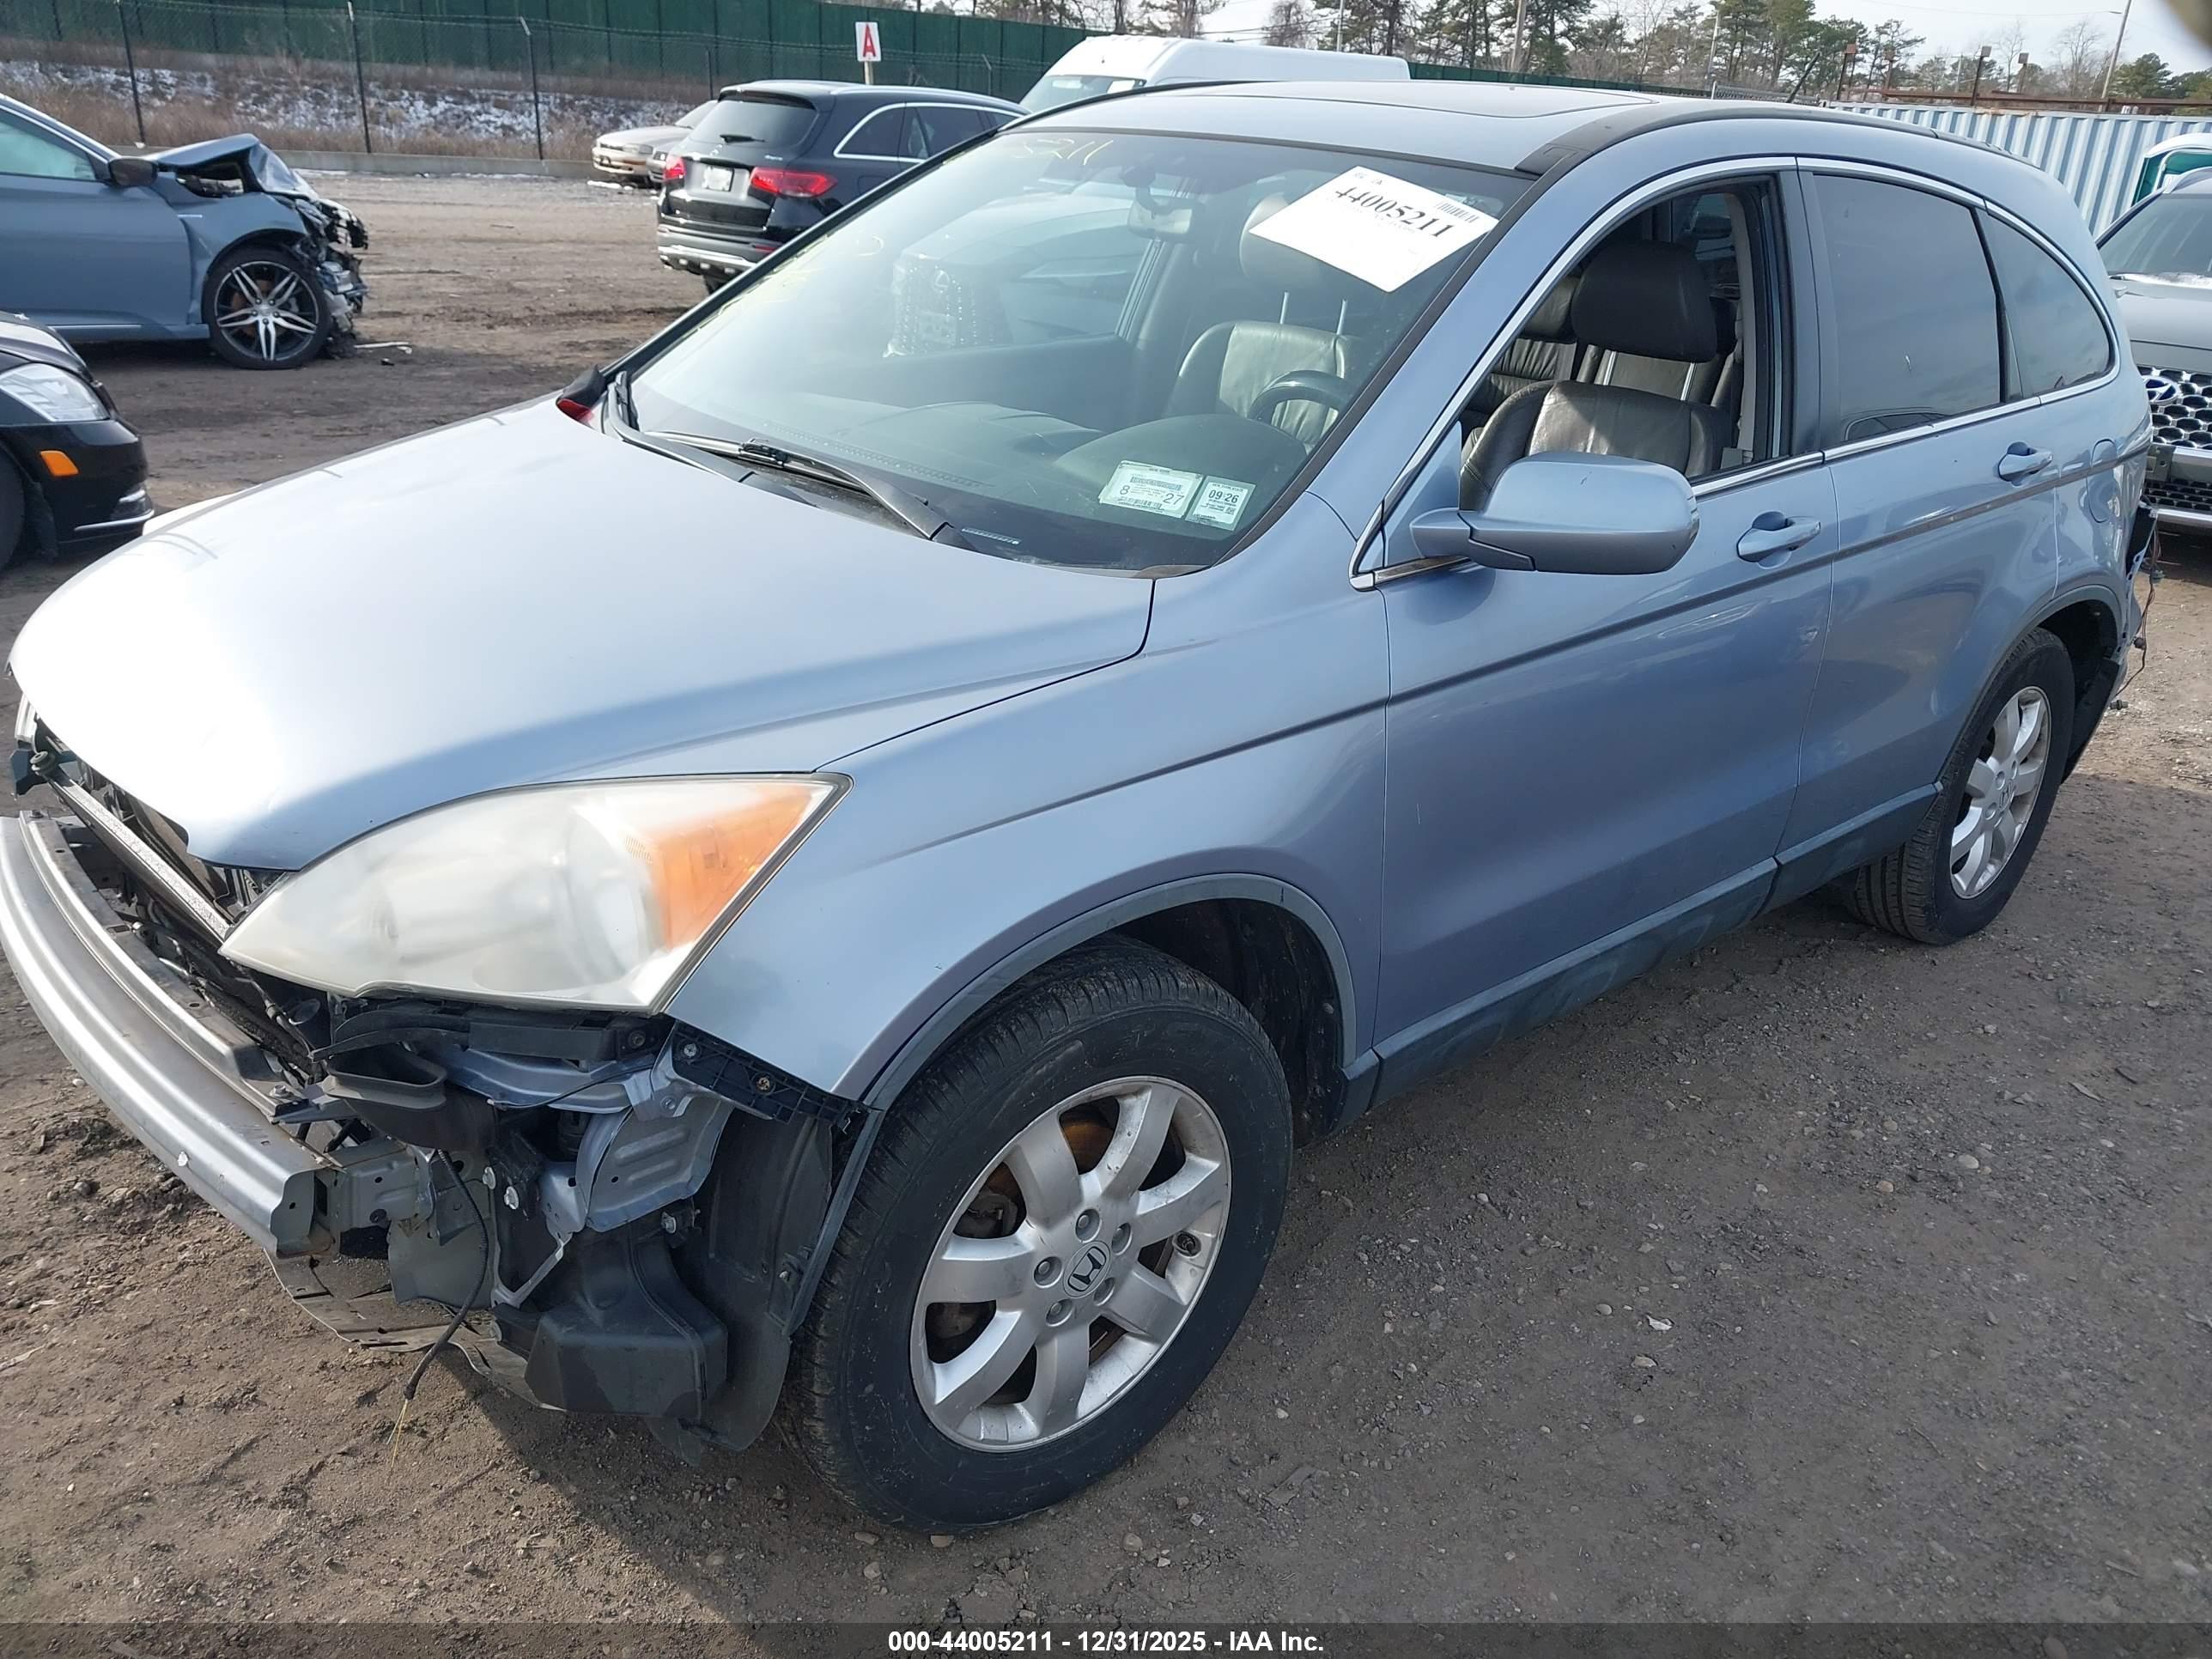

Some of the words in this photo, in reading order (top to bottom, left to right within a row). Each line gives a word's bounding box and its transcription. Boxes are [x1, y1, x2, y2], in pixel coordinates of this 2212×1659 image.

[862, 23, 877, 58] A
[1334, 185, 1455, 247] 44005211
[1119, 484, 1131, 495] 8
[1163, 492, 1185, 506] 27
